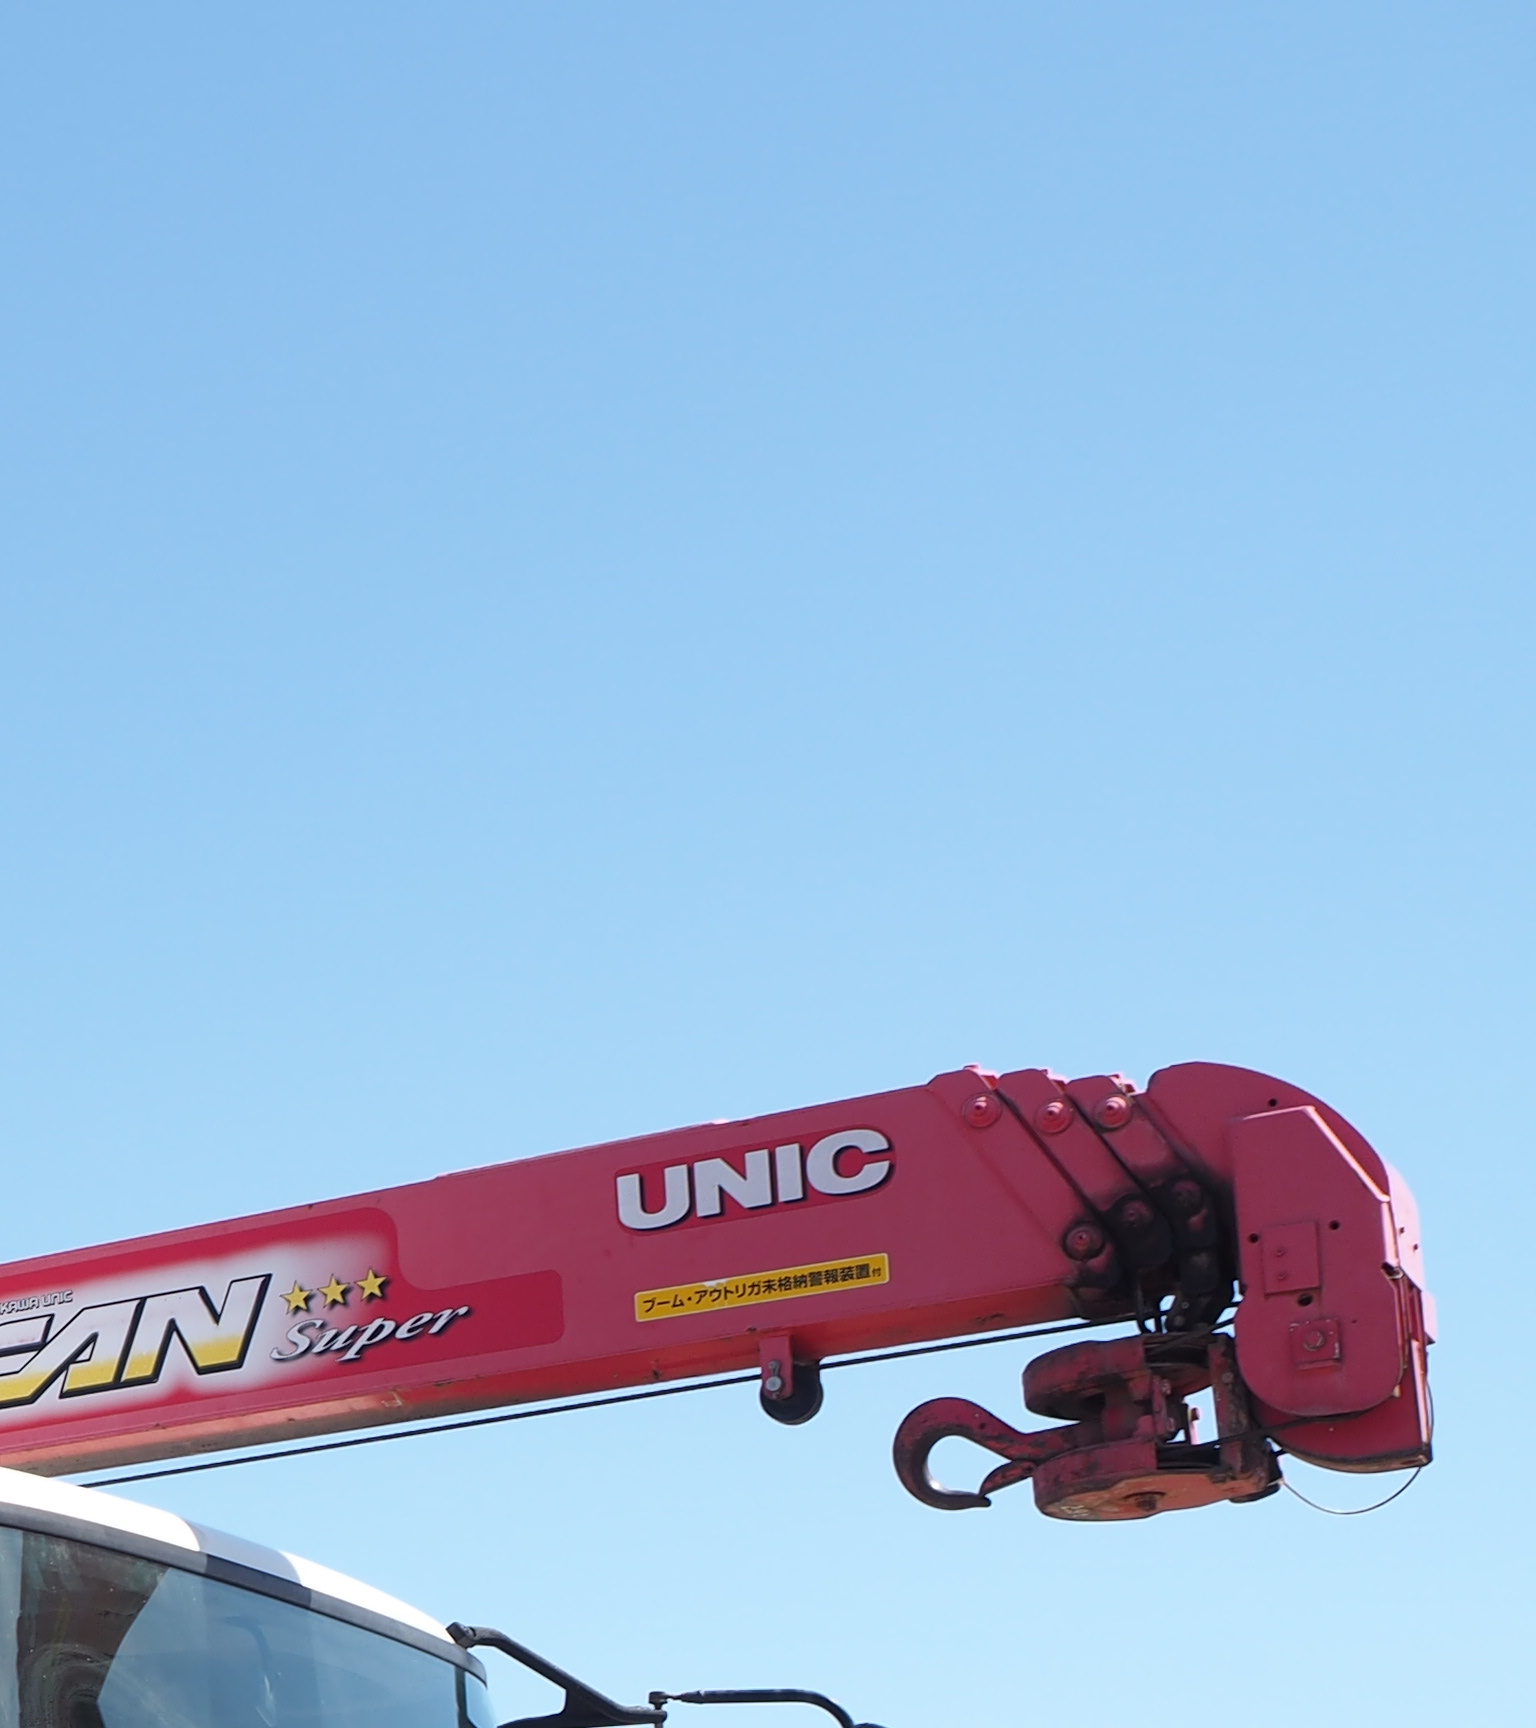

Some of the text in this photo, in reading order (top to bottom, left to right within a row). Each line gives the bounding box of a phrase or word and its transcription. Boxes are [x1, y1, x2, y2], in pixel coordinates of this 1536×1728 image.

[616, 1128, 893, 1232] UNIC
[41, 1289, 74, 1307] UNIC
[269, 1305, 471, 1363] Super
